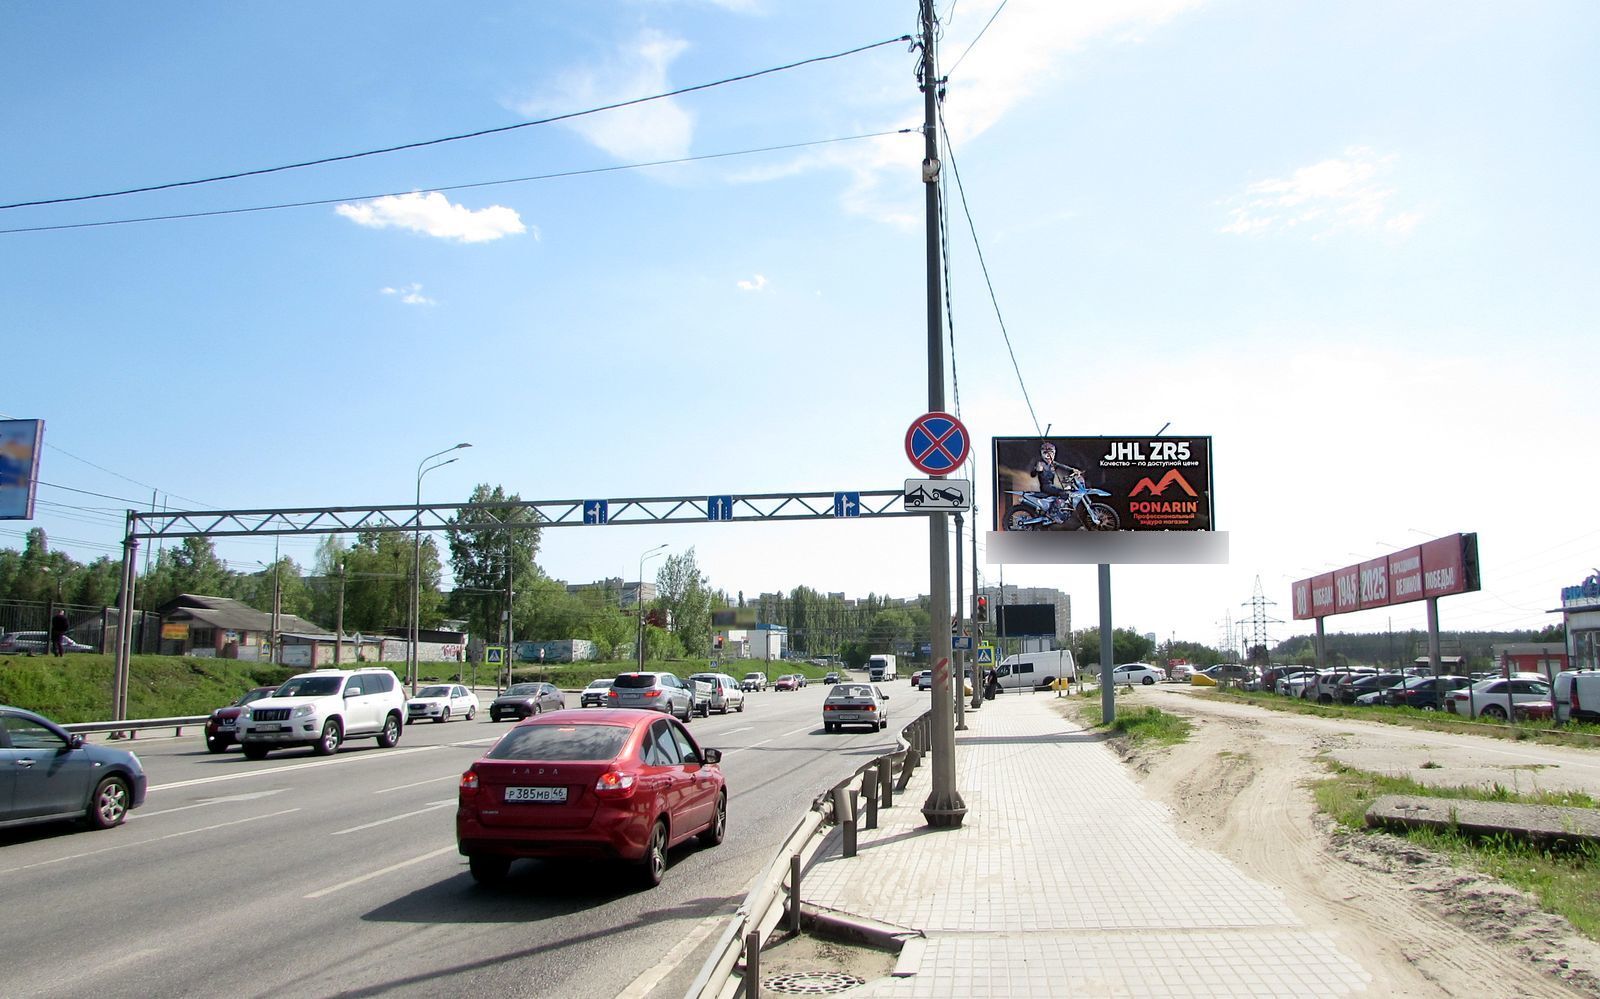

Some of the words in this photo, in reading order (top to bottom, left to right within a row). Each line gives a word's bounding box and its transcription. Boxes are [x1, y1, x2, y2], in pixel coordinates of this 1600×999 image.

[1104, 442, 1145, 460] JHL
[1150, 442, 1190, 460] ZR5
[1129, 501, 1197, 513] PONARIN
[1336, 573, 1357, 607] 1945
[1361, 566, 1386, 602] 2025
[1296, 585, 1307, 615] 80
